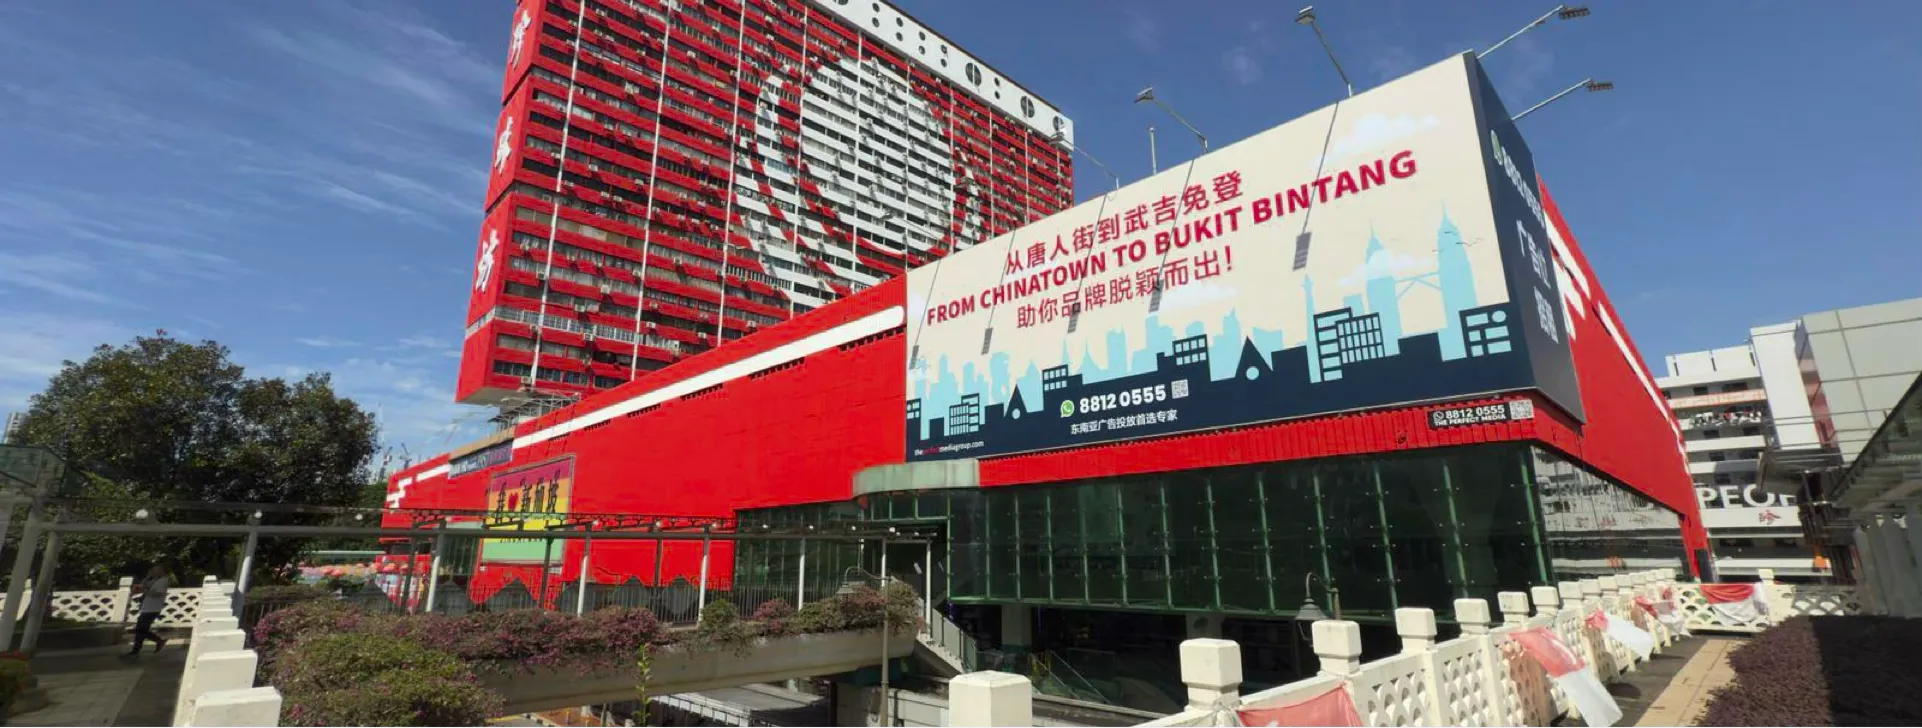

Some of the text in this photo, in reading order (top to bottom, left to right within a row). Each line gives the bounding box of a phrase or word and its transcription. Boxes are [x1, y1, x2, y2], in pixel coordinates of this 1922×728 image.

[927, 149, 1417, 327] FROM CHINATOWN TO BUKIT BINTANG
[1005, 170, 1244, 275] 从唐人街到武吉免登
[1016, 245, 1233, 330] 助你品牌脱颖而出!
[1079, 384, 1167, 413] 8812 0555
[1445, 404, 1505, 419] 8812 0555
